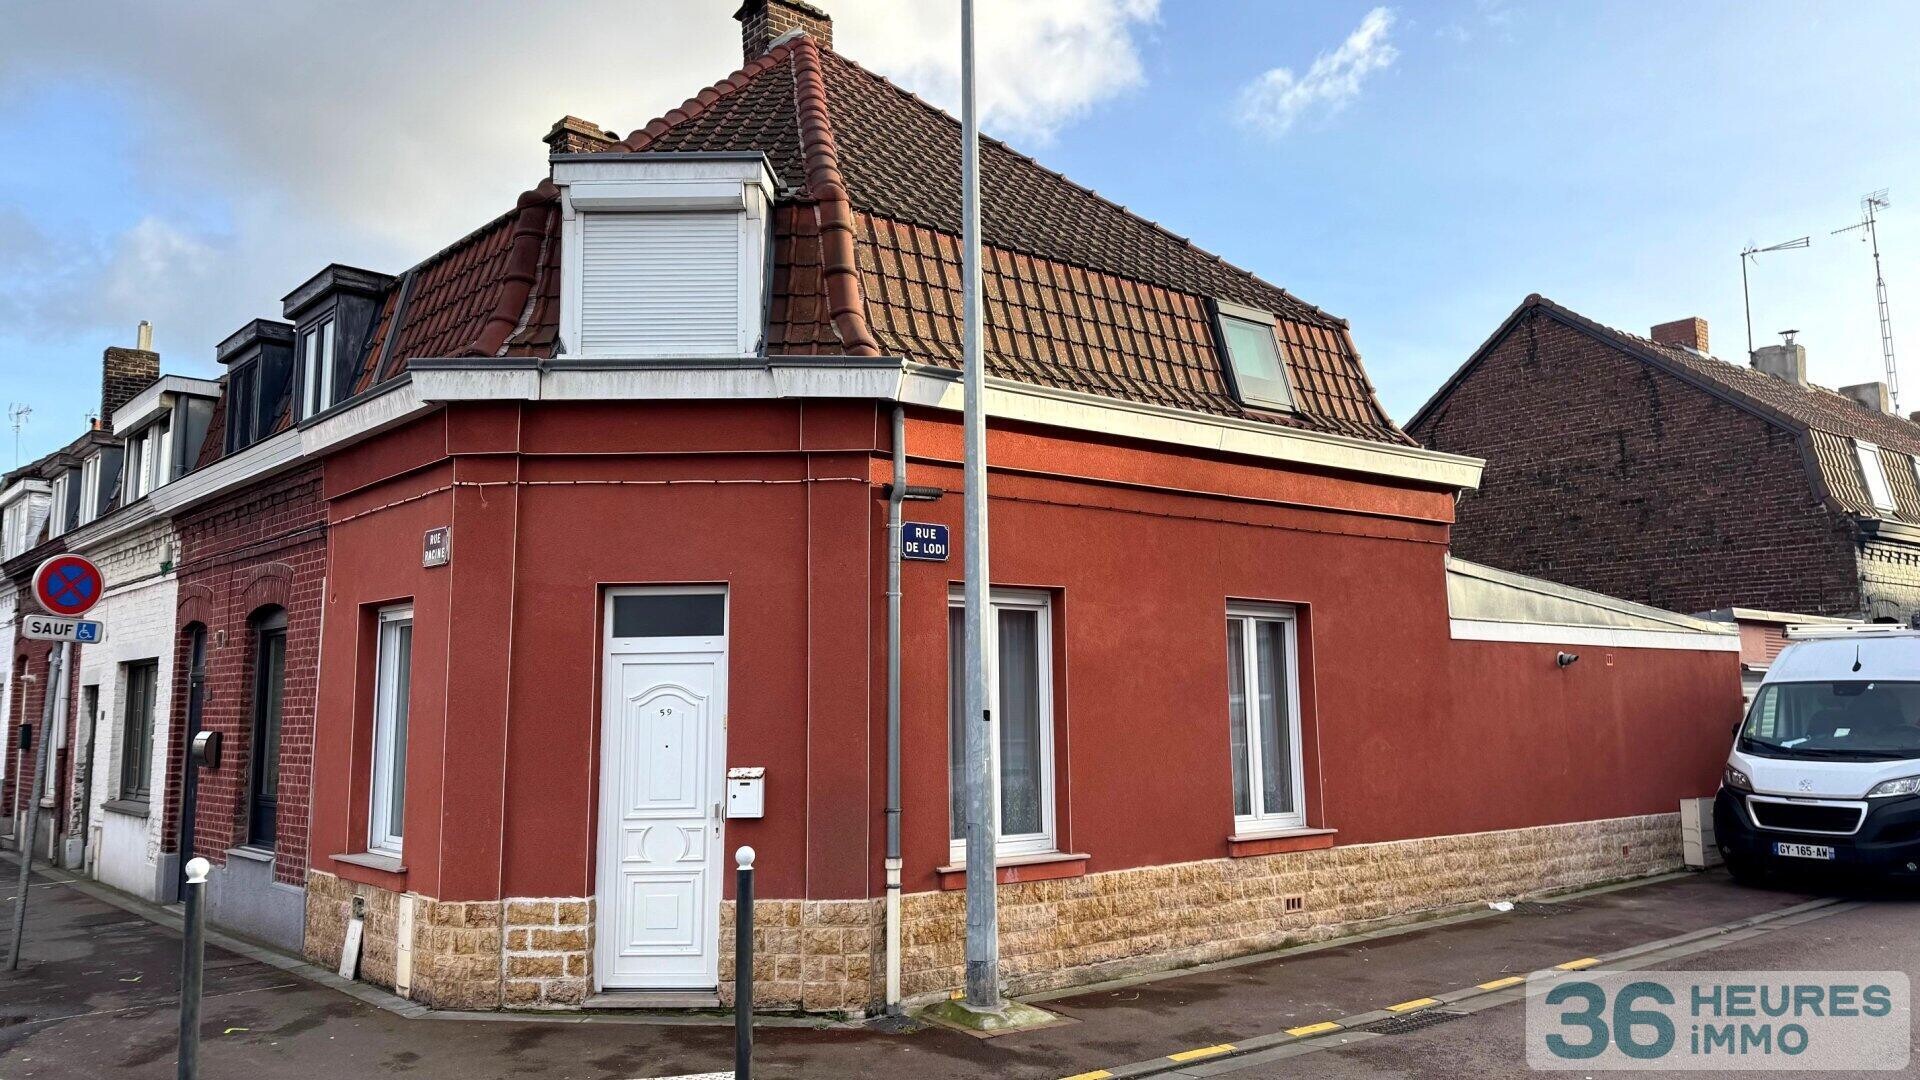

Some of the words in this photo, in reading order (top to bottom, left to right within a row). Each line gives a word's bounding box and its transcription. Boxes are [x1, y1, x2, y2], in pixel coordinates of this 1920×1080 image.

[430, 533, 441, 545] RUE
[915, 527, 937, 540] RUE
[906, 541, 919, 553] DE
[923, 543, 945, 555] LODI
[31, 621, 74, 636] SAUF
[659, 708, 672, 717] 59
